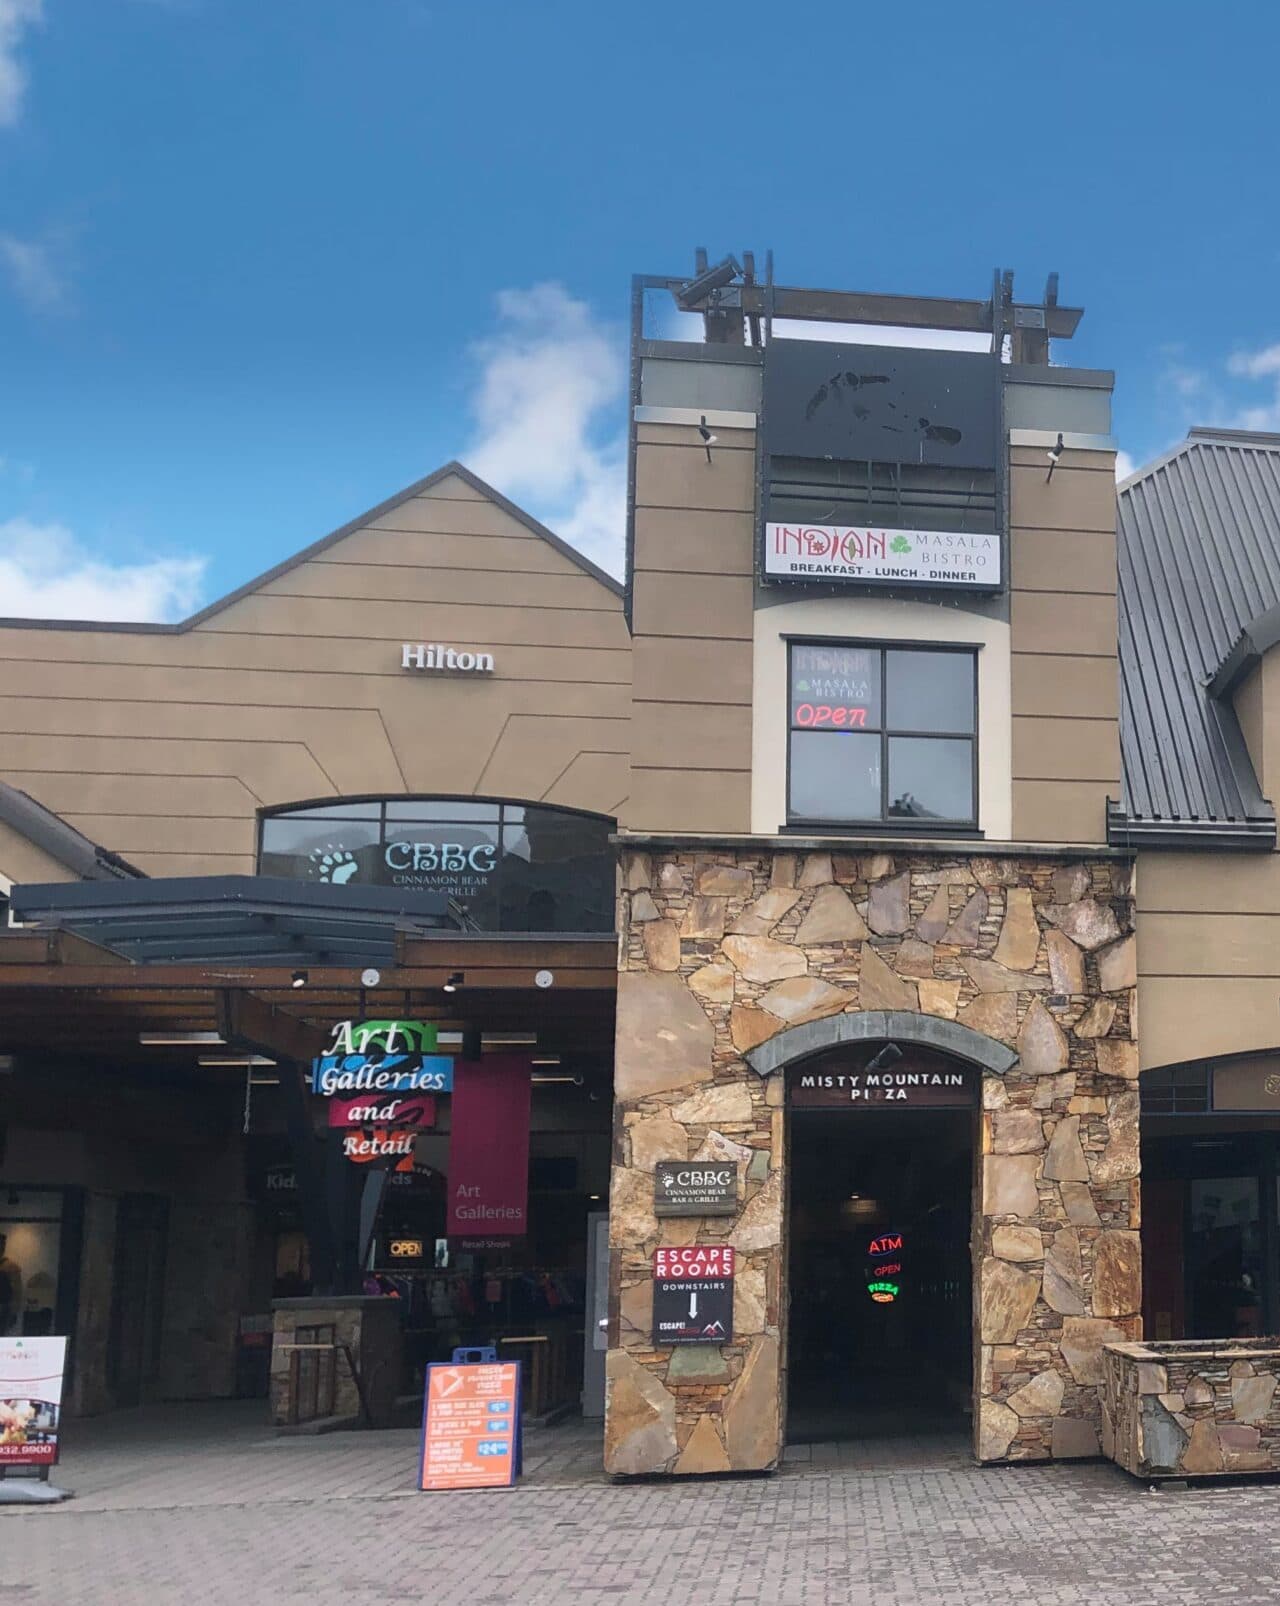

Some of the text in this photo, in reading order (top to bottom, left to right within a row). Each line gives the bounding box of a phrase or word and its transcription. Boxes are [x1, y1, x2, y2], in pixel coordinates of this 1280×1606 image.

[775, 527, 887, 564] INDIAN
[915, 534, 992, 550] MASALA
[922, 552, 987, 566] BISTRO
[790, 563, 863, 575] BREAKFAST
[875, 567, 918, 578] LUNCH
[929, 570, 976, 581] DINNER
[401, 644, 494, 671] Hilton
[811, 679, 868, 689] MASALA
[385, 842, 497, 872] CBBG
[392, 874, 488, 885] CINNAMON BEAR
[321, 1020, 403, 1056] Art
[321, 1063, 446, 1096] Galleries
[801, 1073, 963, 1087] MISTY MOUNTAIN
[851, 1089, 907, 1100] PIZA
[348, 1099, 402, 1120] and
[343, 1133, 417, 1156] Retail
[677, 1171, 731, 1186] CBBG
[456, 1184, 481, 1198] Art
[455, 1205, 522, 1220] Galleries
[390, 1241, 422, 1256] OPEN
[870, 1236, 902, 1252] ATM
[657, 1249, 732, 1263] ESCAPE
[657, 1263, 731, 1276] ROOMS
[874, 1264, 901, 1277] OPEN
[662, 1283, 725, 1291] DOWNSTAIRS
[868, 1282, 899, 1296] PIZZA
